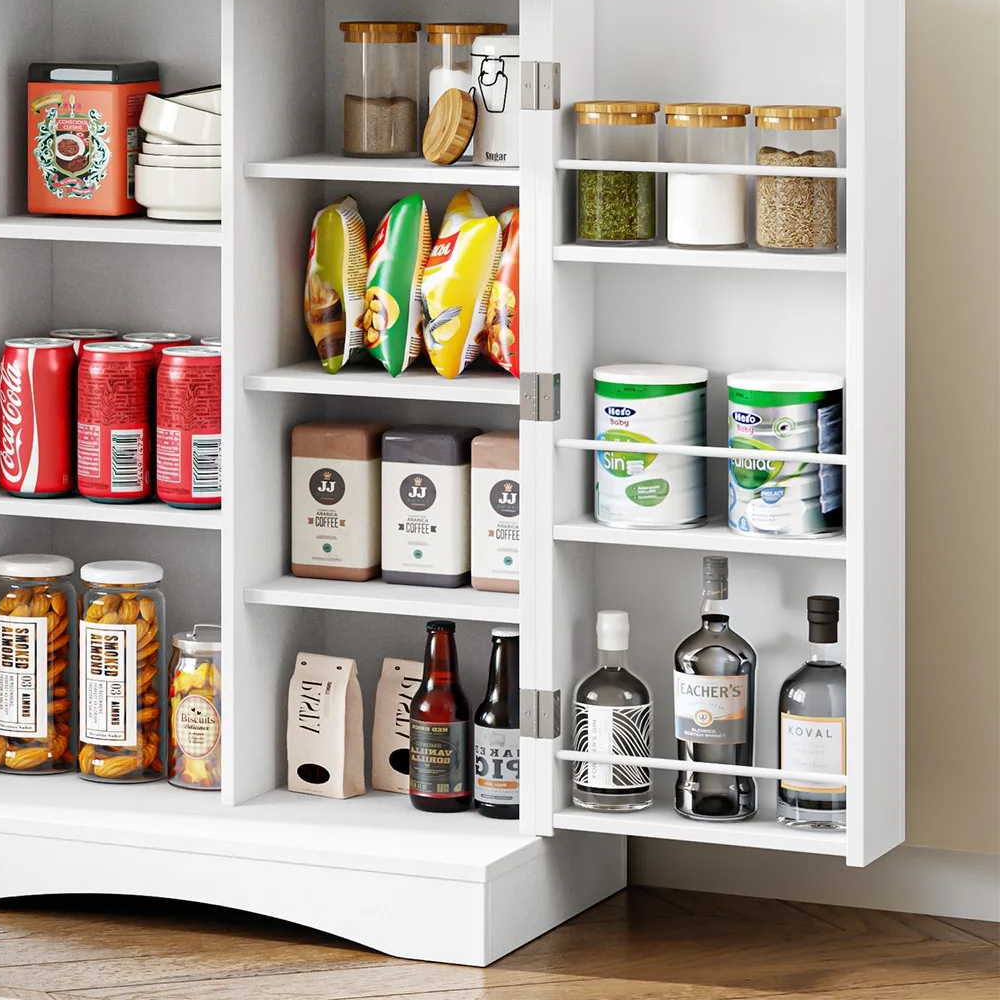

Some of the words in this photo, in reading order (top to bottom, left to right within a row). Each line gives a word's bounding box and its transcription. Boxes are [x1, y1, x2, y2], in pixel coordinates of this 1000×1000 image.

[485, 151, 507, 162] Sugar
[608, 407, 631, 416] Hero
[734, 412, 756, 423] Hero
[609, 418, 629, 428] Baby
[736, 424, 755, 436] Baby
[604, 451, 625, 471] Sin
[317, 481, 336, 493] JJ
[408, 486, 427, 498] JJ
[498, 492, 518, 504] JJ
[315, 516, 339, 528] COFFEE
[405, 522, 430, 534] COFFEE
[495, 528, 520, 540] COFFEE
[2, 626, 13, 667] ALMOND
[15, 628, 29, 669] SMOKED
[91, 633, 102, 675] ALMOND
[104, 635, 119, 677] SMOKED
[21, 675, 32, 688] 03
[110, 683, 122, 695] 03
[679, 682, 741, 698] EACHER'S
[22, 693, 30, 718] ALMOND
[111, 701, 120, 725] ALMOND
[181, 713, 215, 724] Biscuits
[788, 725, 833, 739] KOVAL
